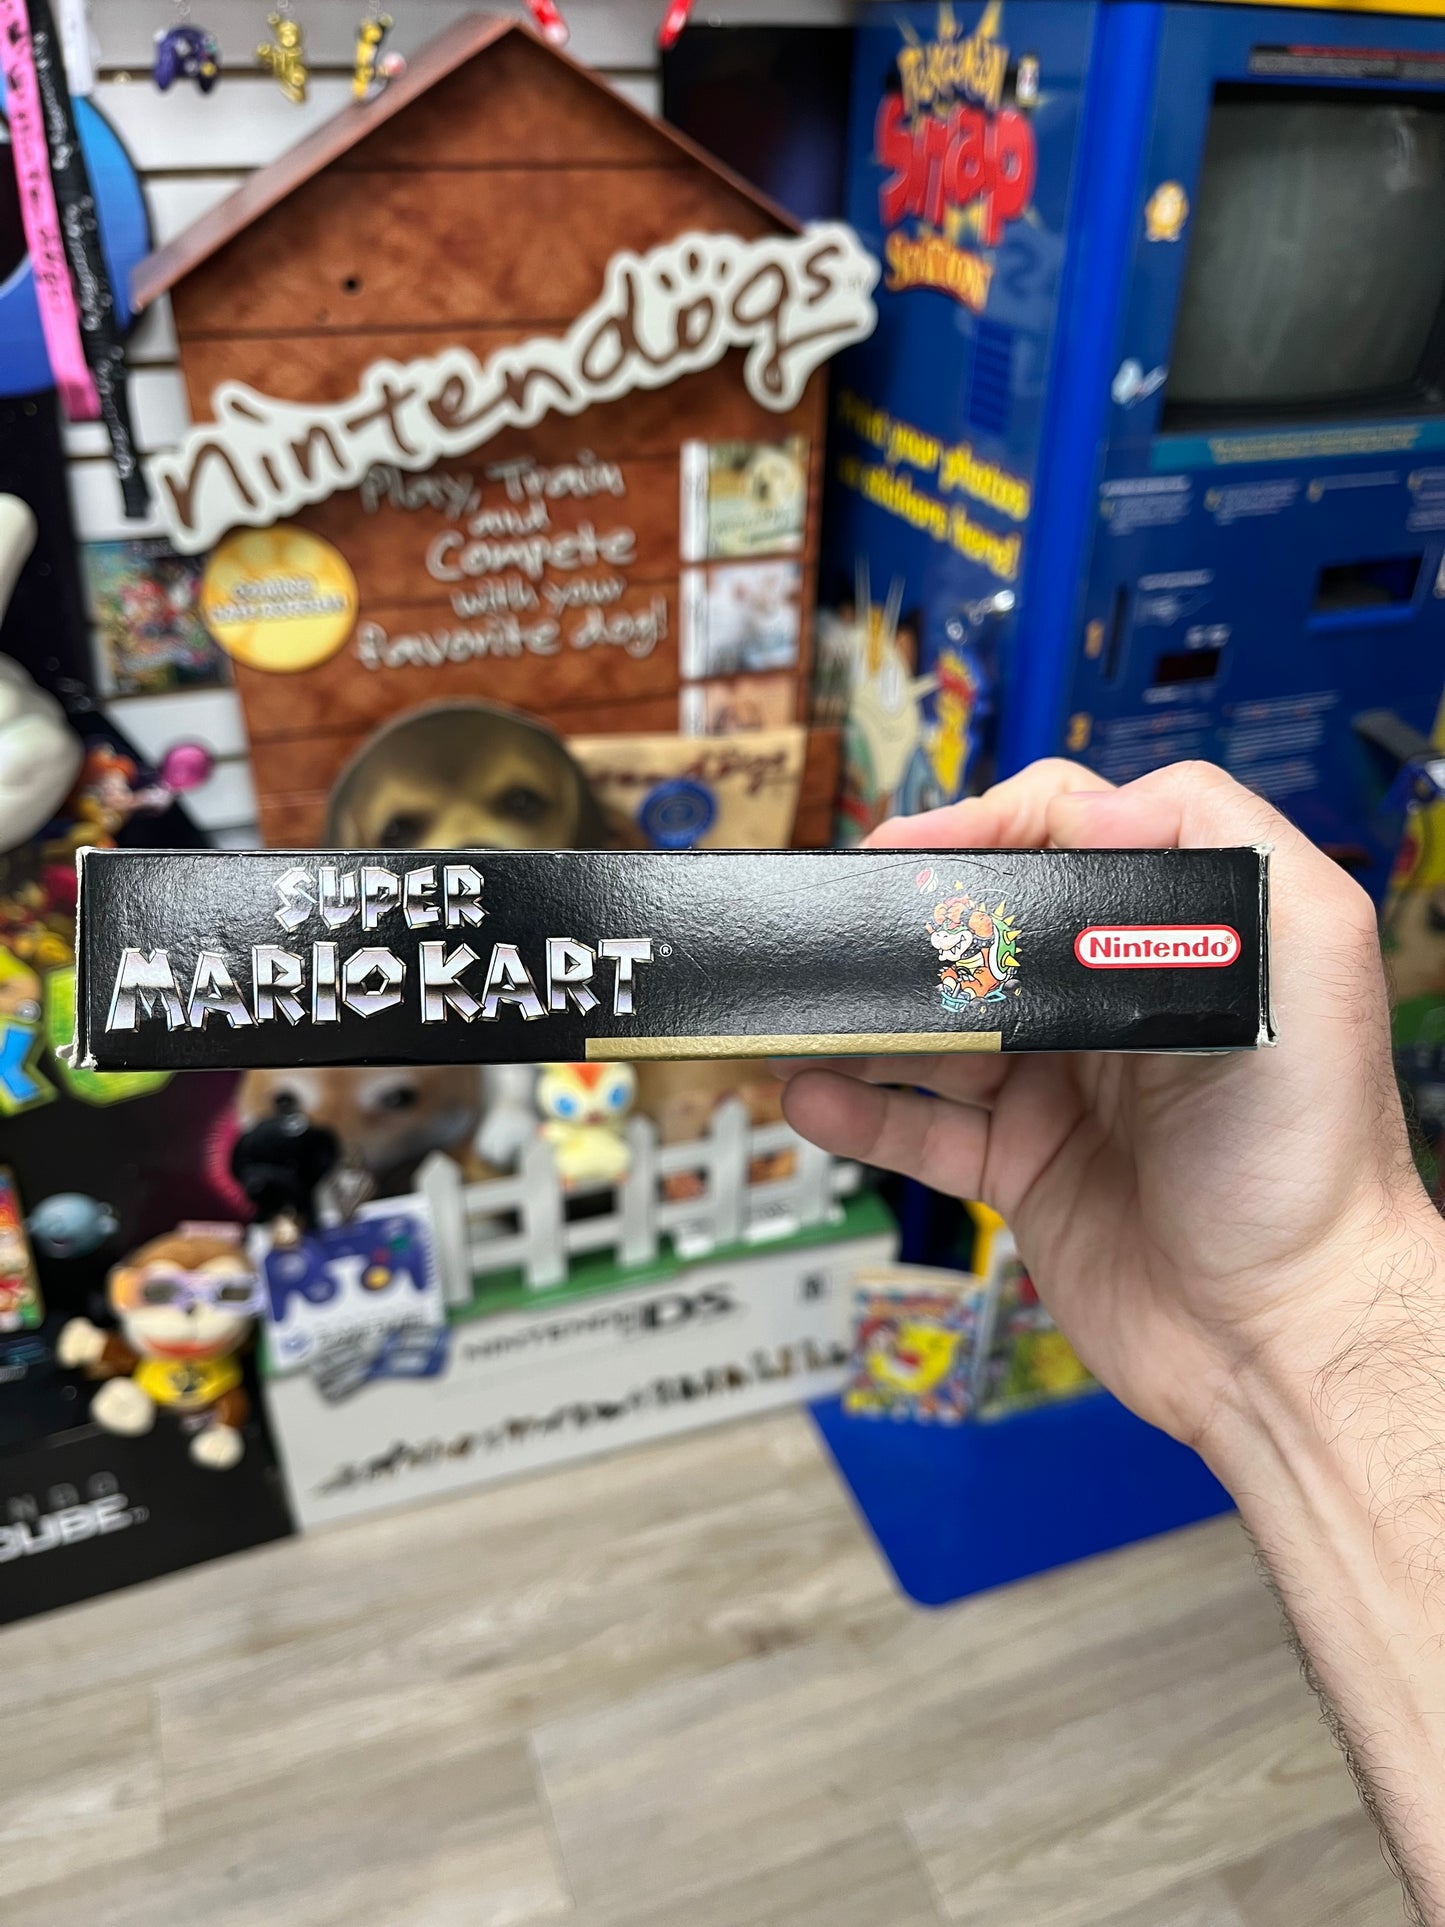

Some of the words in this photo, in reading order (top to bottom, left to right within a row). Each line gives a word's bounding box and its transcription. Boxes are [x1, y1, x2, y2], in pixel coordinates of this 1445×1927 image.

[164, 246, 860, 530] nintendogs
[486, 449, 627, 502] Train
[467, 498, 550, 537] and
[425, 532, 637, 581] Compete
[452, 574, 540, 619] with
[541, 576, 626, 617] your
[356, 611, 560, 670] favorite
[273, 864, 491, 933] SUPER
[1089, 936, 1229, 958] Nintendo
[105, 940, 406, 1033] MARIO
[418, 937, 653, 1024] KART
[640, 1280, 737, 1335] DS
